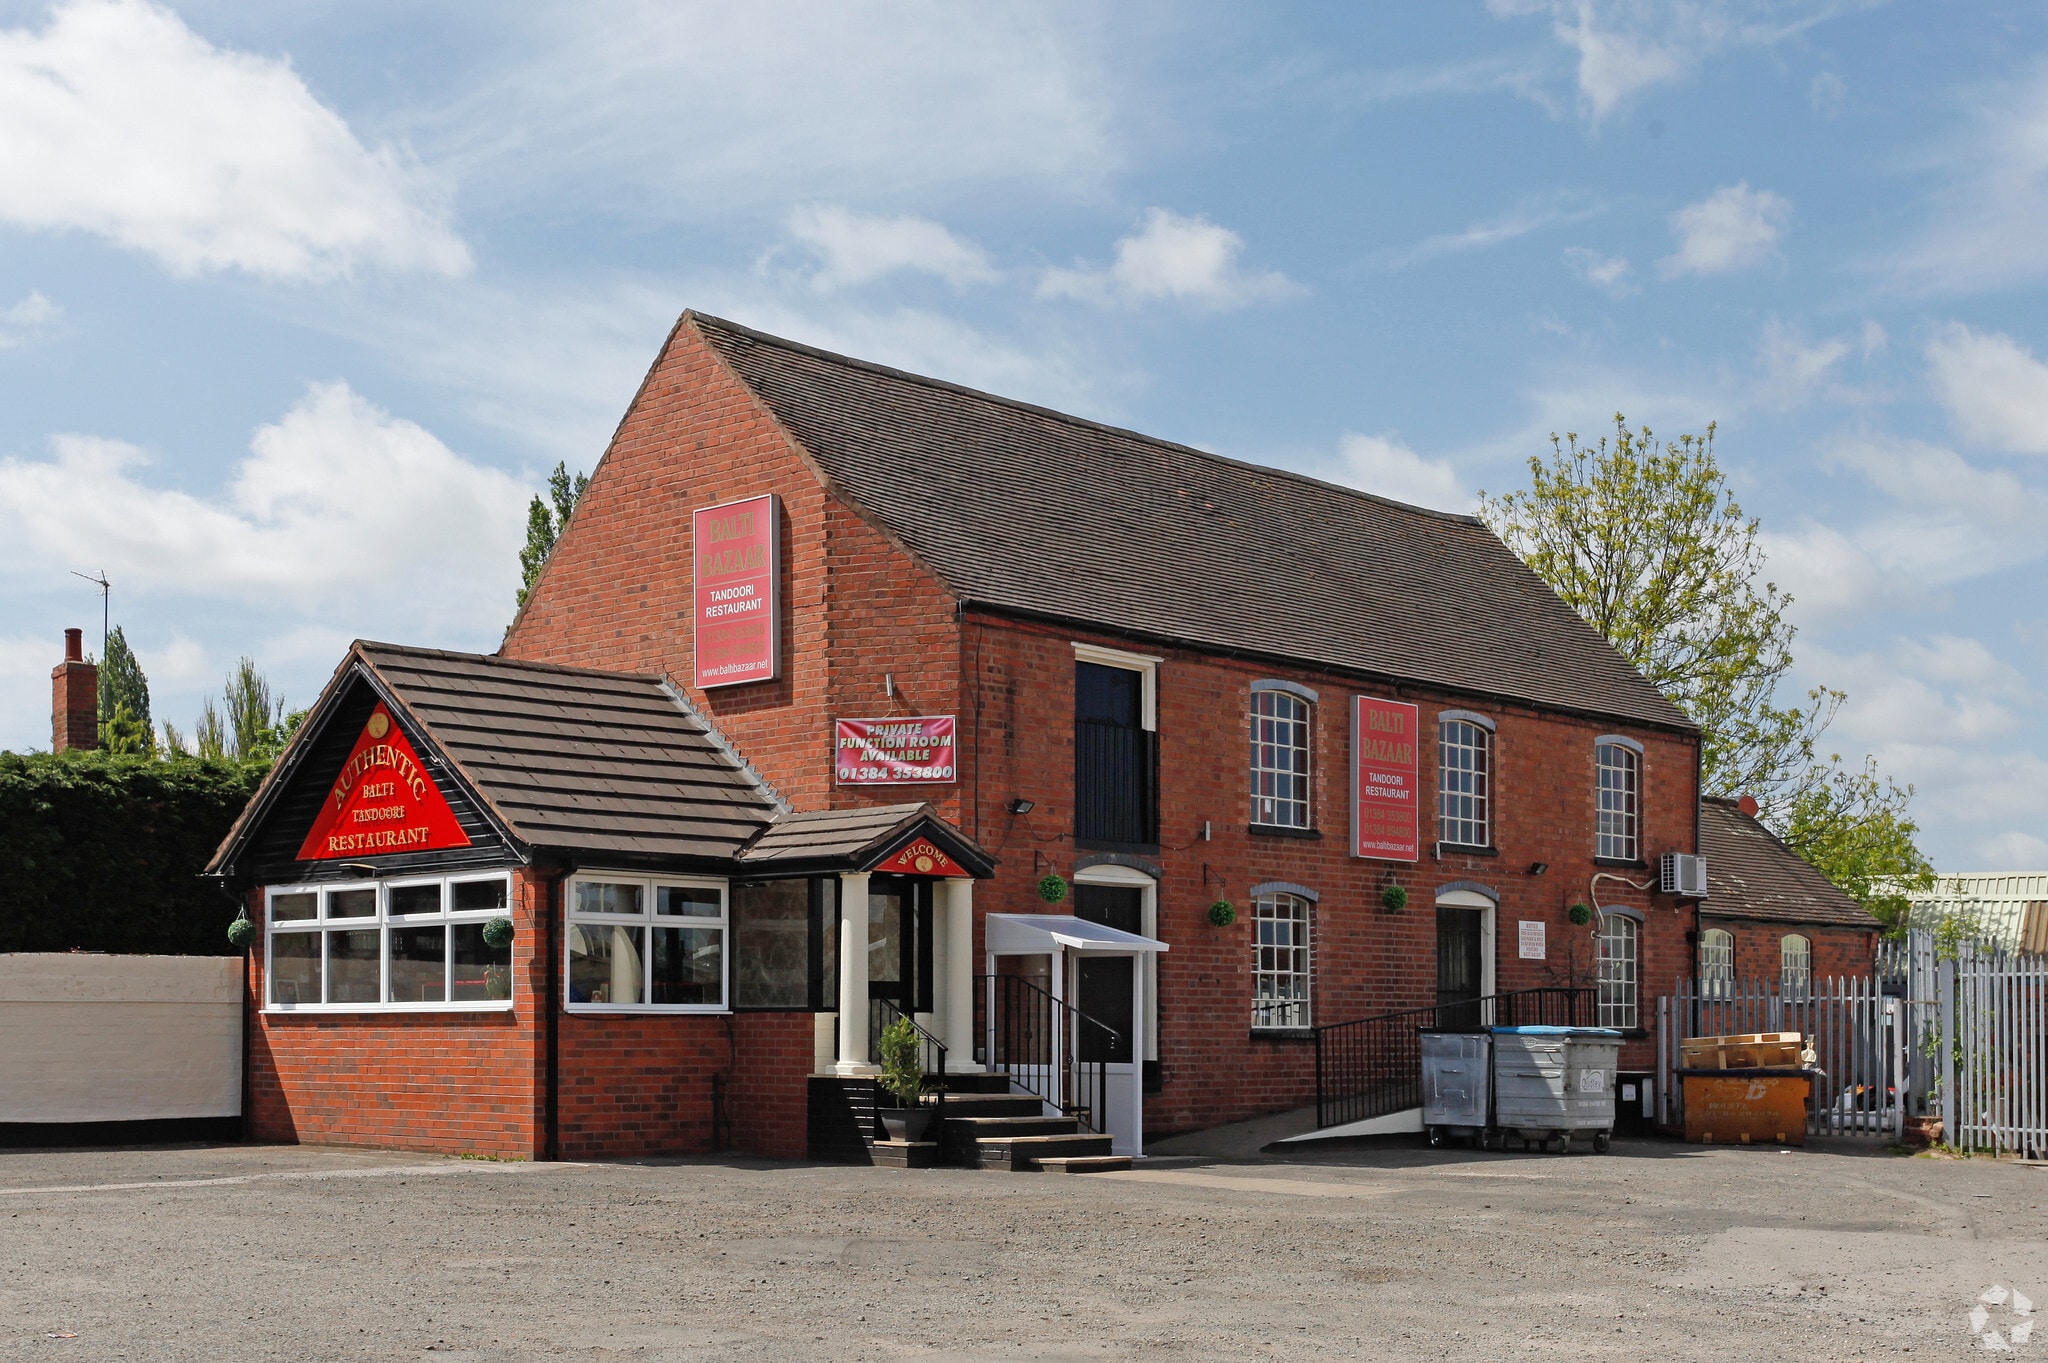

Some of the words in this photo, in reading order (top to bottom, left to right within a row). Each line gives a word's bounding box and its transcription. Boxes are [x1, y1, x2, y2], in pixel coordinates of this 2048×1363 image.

[709, 512, 755, 544] BALTI
[702, 544, 766, 578] BAZAAR
[710, 584, 754, 602] TANDOORI
[706, 598, 762, 618] RESTAURANT
[702, 659, 768, 677] www.baltibazaar.net
[866, 723, 922, 736] PRIVATE
[1369, 708, 1404, 735] BALTI
[840, 736, 906, 749] FUNCTION
[909, 735, 951, 748] ROOM
[860, 749, 931, 762] AVAILABLE
[1363, 737, 1412, 765] BAZAAR
[333, 744, 427, 810] AUTHENTIC
[840, 767, 888, 780] 01384
[893, 766, 953, 779] 353800
[1369, 772, 1403, 786] TANDOORI
[363, 782, 395, 799] BALTI
[1365, 785, 1410, 800] RESTAURANT
[352, 805, 405, 822] TANDOORI
[1364, 807, 1385, 820] 01384
[1364, 822, 1385, 835] 01384
[328, 827, 429, 851] RESTAURANT
[1363, 839, 1414, 853] www.baltibazaar.net
[897, 844, 949, 868] WELCOME
